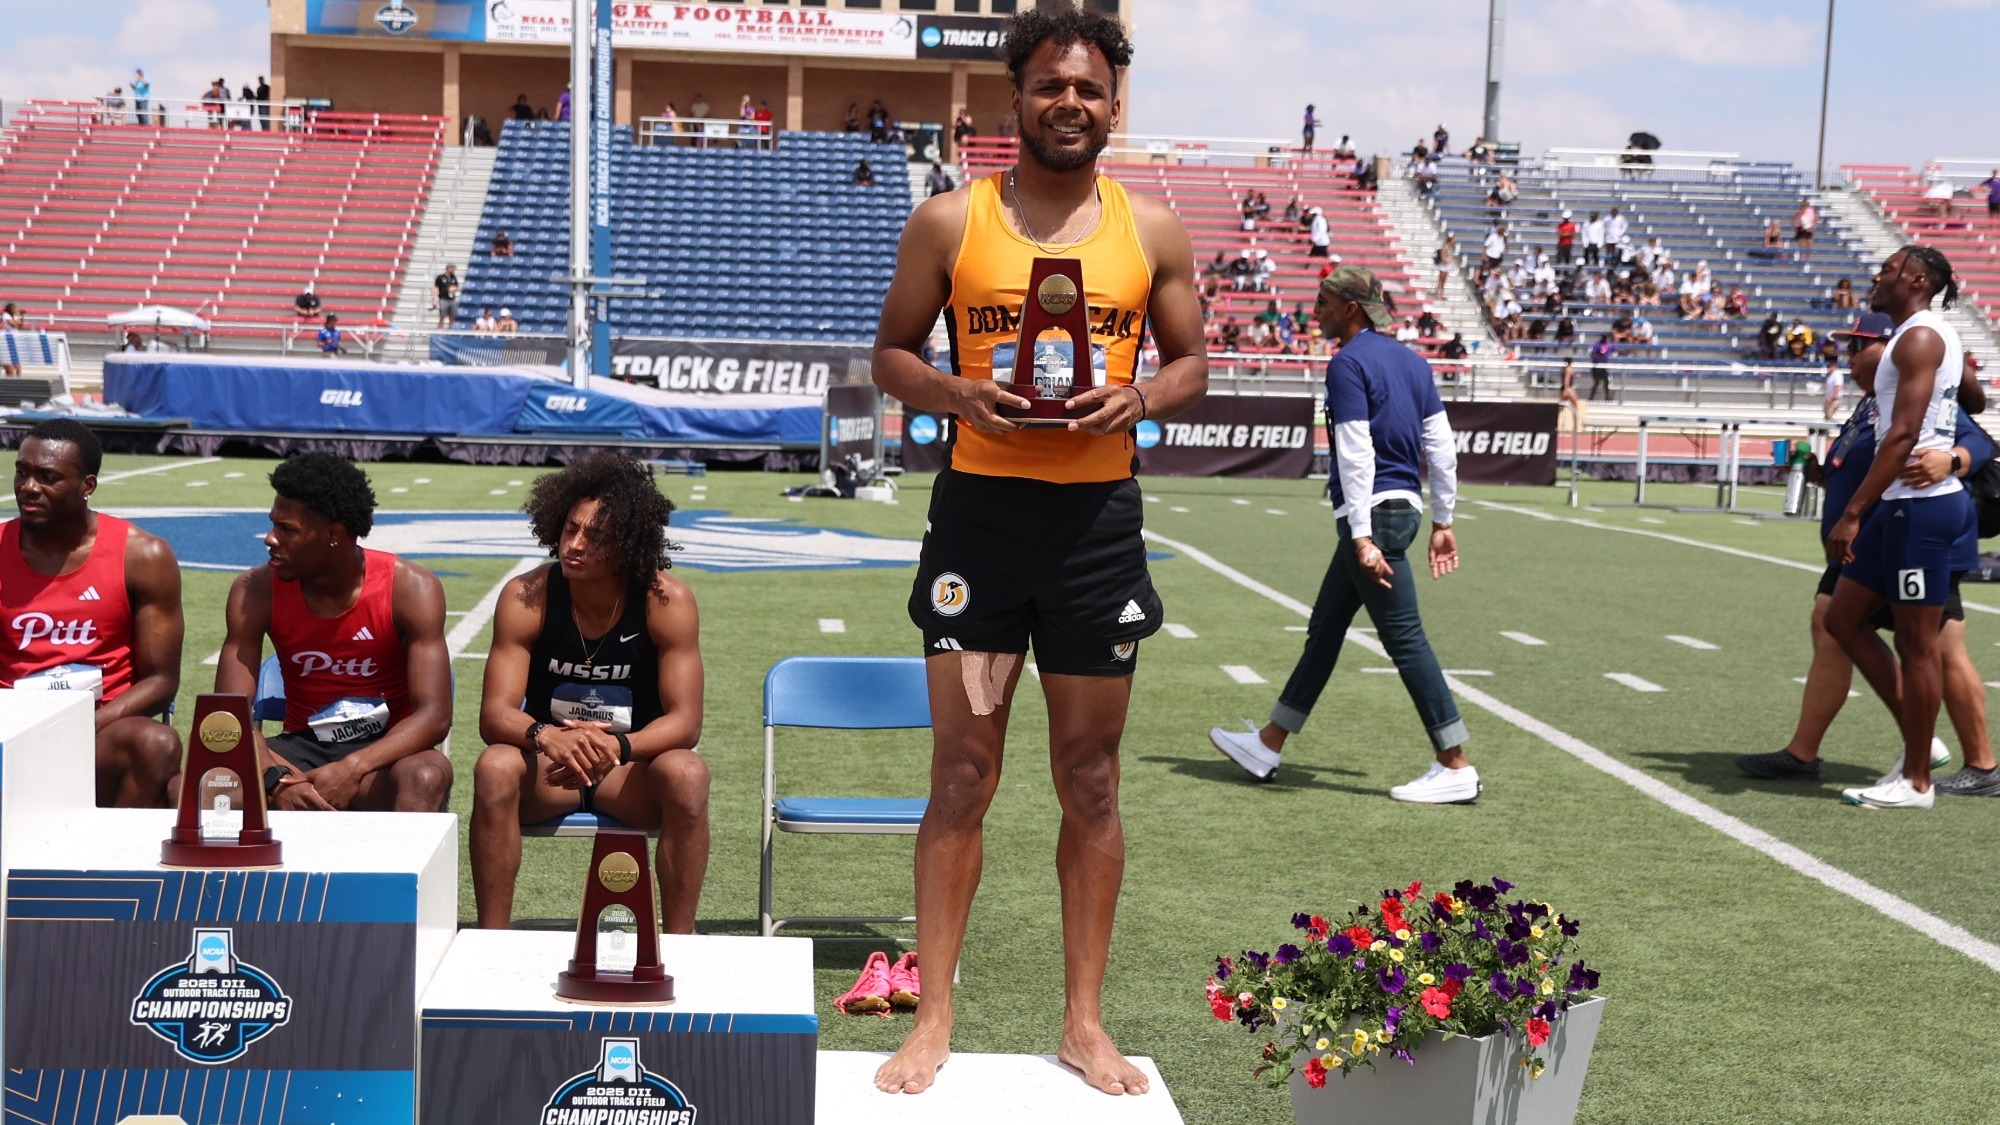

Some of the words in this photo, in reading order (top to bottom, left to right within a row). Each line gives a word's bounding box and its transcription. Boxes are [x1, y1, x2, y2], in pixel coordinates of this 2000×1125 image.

[521, 15, 555, 25] NCAA
[674, 6, 833, 26] FOOTBALL
[736, 25, 773, 33] RMAC
[778, 26, 885, 38] CHAMPIONSHIPS
[942, 28, 986, 47] TRACK
[986, 30, 998, 47] &
[596, 28, 611, 120] CHAMPIONSHIPS
[596, 120, 610, 150] FIELD
[596, 160, 610, 196] TRACK
[967, 306, 1138, 338] DOMCAN
[612, 355, 714, 390] TRACK
[715, 358, 740, 392] &
[742, 359, 830, 395] FIELD
[320, 389, 363, 407] GILL
[545, 395, 587, 412] GILL
[1164, 423, 1232, 447] TRACK
[1231, 424, 1249, 448] &
[1249, 425, 1307, 449] FIELD
[1472, 430, 1490, 454] &
[1490, 431, 1551, 455] FIELD
[1903, 571, 1920, 598] 6
[1118, 613, 1146, 624] adidas
[12, 612, 98, 650] Pitt
[291, 651, 379, 677] Pitt
[548, 658, 632, 681] MSSU
[47, 680, 72, 690] JOEL
[568, 706, 614, 722] JADARIUS
[203, 730, 240, 743] NCAA
[601, 870, 638, 882] NCAA
[202, 947, 225, 956] NCAA
[178, 979, 218, 988] 2025
[221, 979, 246, 988] DII
[163, 988, 201, 998] OUTDOOR
[202, 988, 228, 998] TRACK
[230, 988, 236, 998] &
[237, 988, 261, 998] FIELD
[136, 1000, 287, 1019] CHAMPIONSHIPS
[610, 1056, 632, 1065] NCAA
[586, 1087, 625, 1096] 2025
[628, 1088, 652, 1097] DII
[572, 1096, 609, 1106] OUTDOOR
[610, 1096, 636, 1106] TRACK
[636, 1097, 642, 1106] &
[643, 1097, 666, 1107] FIELD
[546, 1108, 691, 1125] CHAMPIONSHIPS
